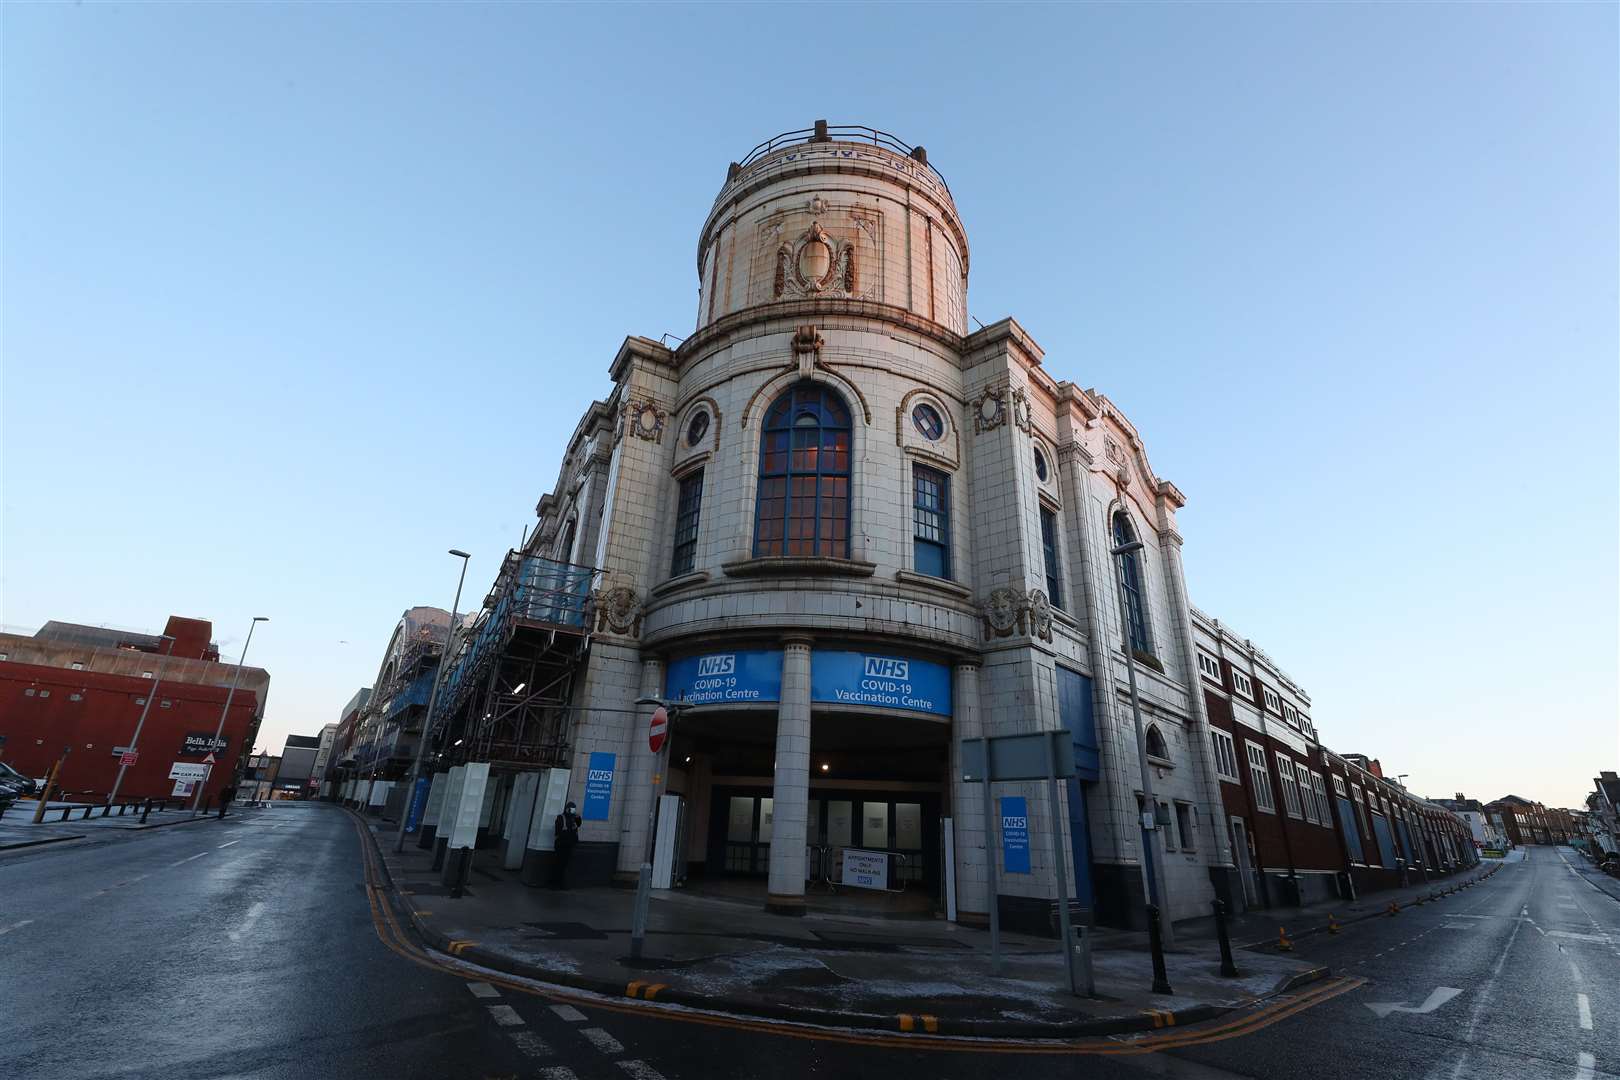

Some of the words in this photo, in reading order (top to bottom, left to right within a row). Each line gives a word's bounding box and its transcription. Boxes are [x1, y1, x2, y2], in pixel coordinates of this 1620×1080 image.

[699, 656, 734, 675] NHS
[866, 658, 907, 679] NHS
[694, 677, 737, 690] COVID-19
[861, 679, 912, 695] COVID-19
[680, 690, 722, 703] accination
[725, 688, 759, 699] Centre
[835, 689, 898, 705] Vaccination
[901, 695, 933, 709] Centre
[185, 736, 205, 745] Bella
[589, 770, 612, 781] NHS
[1004, 817, 1026, 828] NHS
